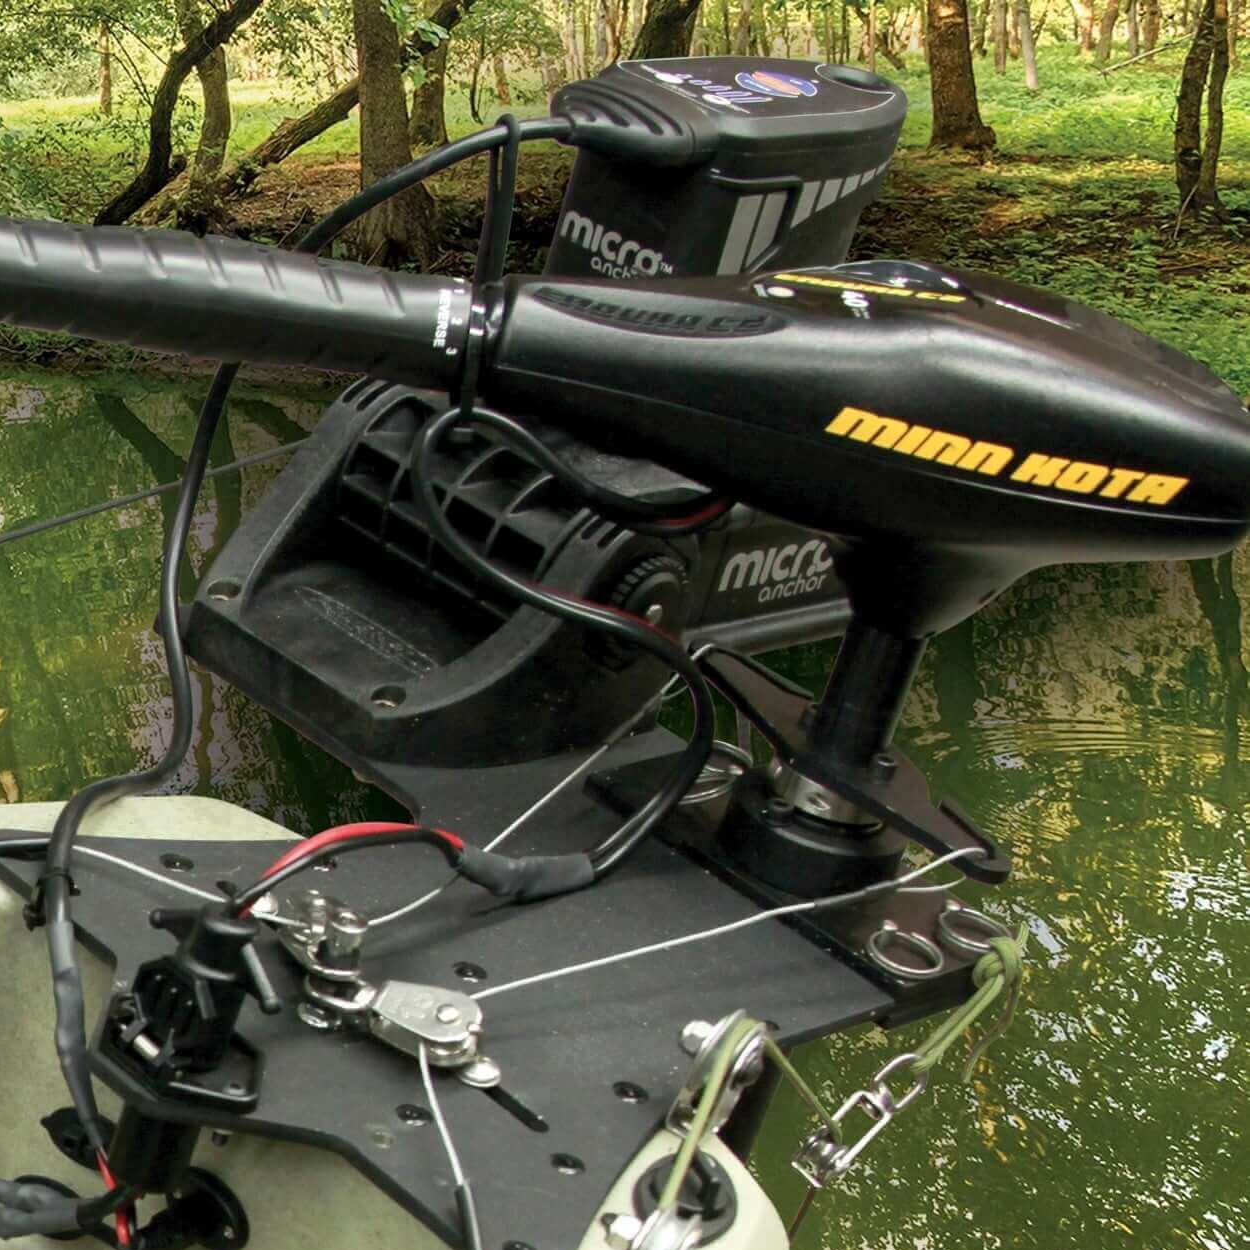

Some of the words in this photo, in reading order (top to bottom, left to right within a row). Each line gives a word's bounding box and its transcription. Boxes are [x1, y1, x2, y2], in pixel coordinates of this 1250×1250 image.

[560, 210, 662, 275] micro
[591, 256, 639, 279] anch
[825, 406, 1014, 476] MINN
[1009, 453, 1190, 505] KOTA
[757, 573, 827, 603] anchor
